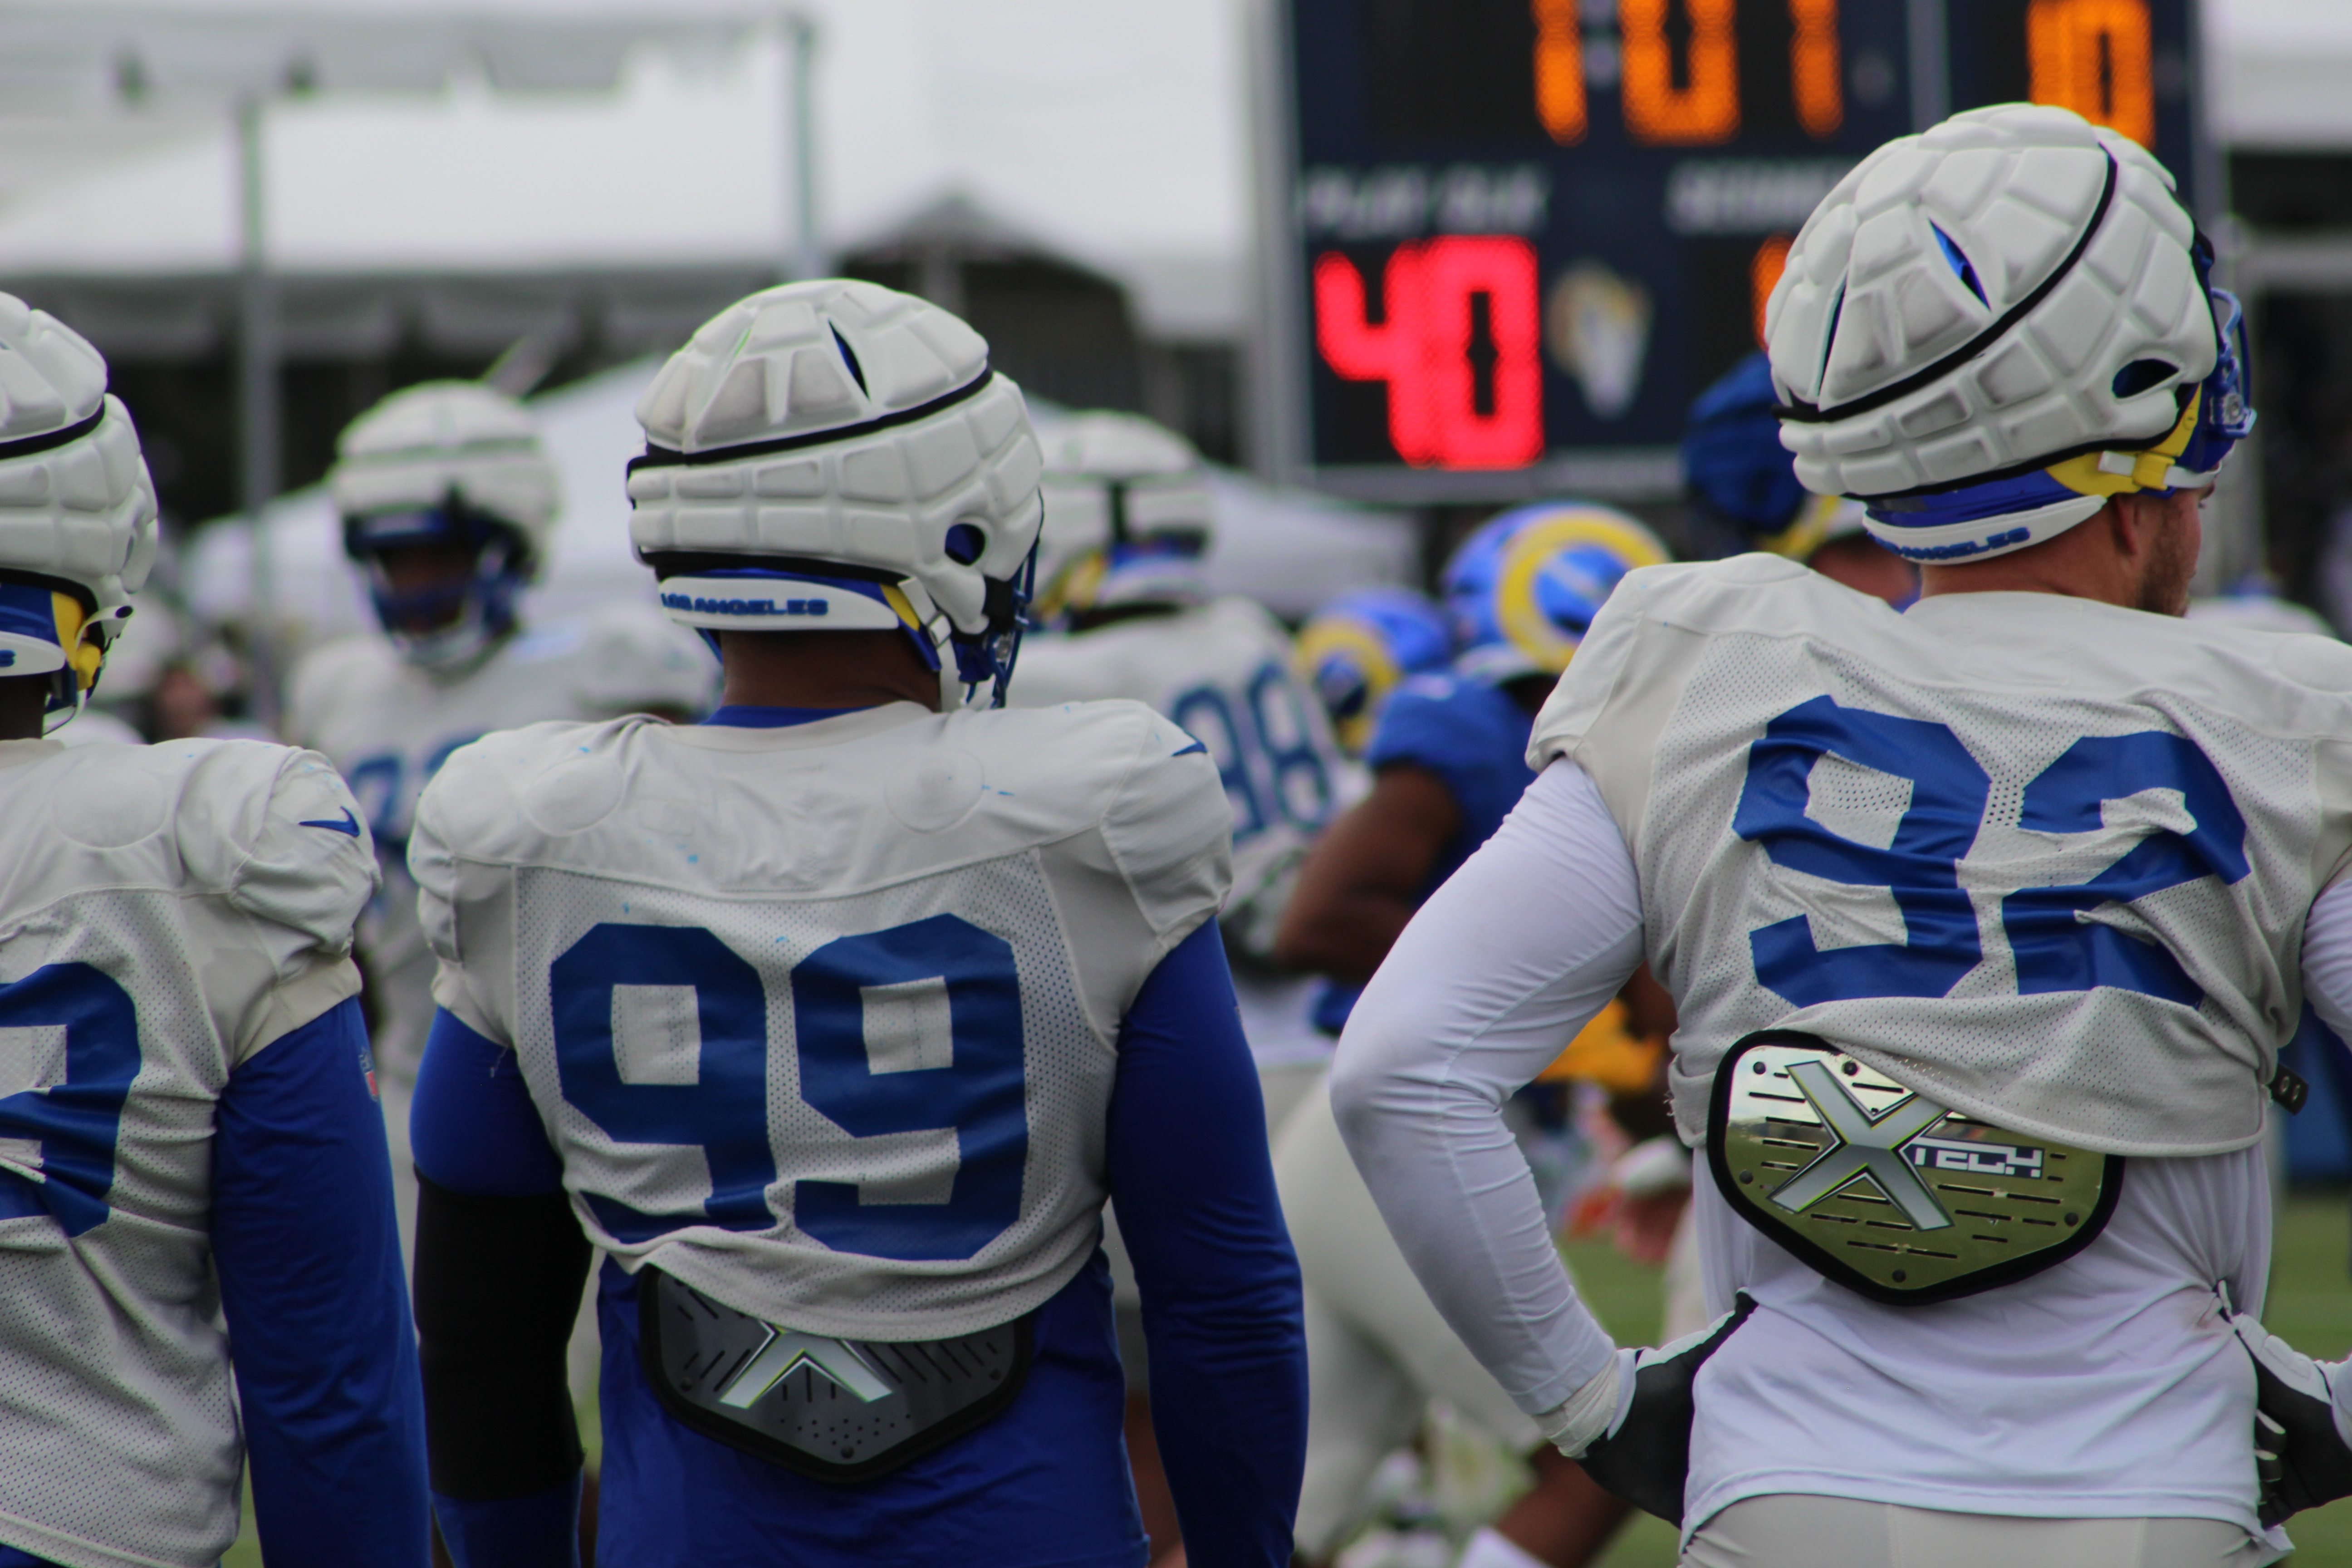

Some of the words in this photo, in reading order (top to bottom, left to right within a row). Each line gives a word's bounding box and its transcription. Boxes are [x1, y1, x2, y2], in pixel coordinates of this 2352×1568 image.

[1313, 234, 1545, 472] 40
[694, 597, 828, 616] ANGELES
[1731, 694, 2251, 1011] 92
[549, 912, 1029, 1261] 99
